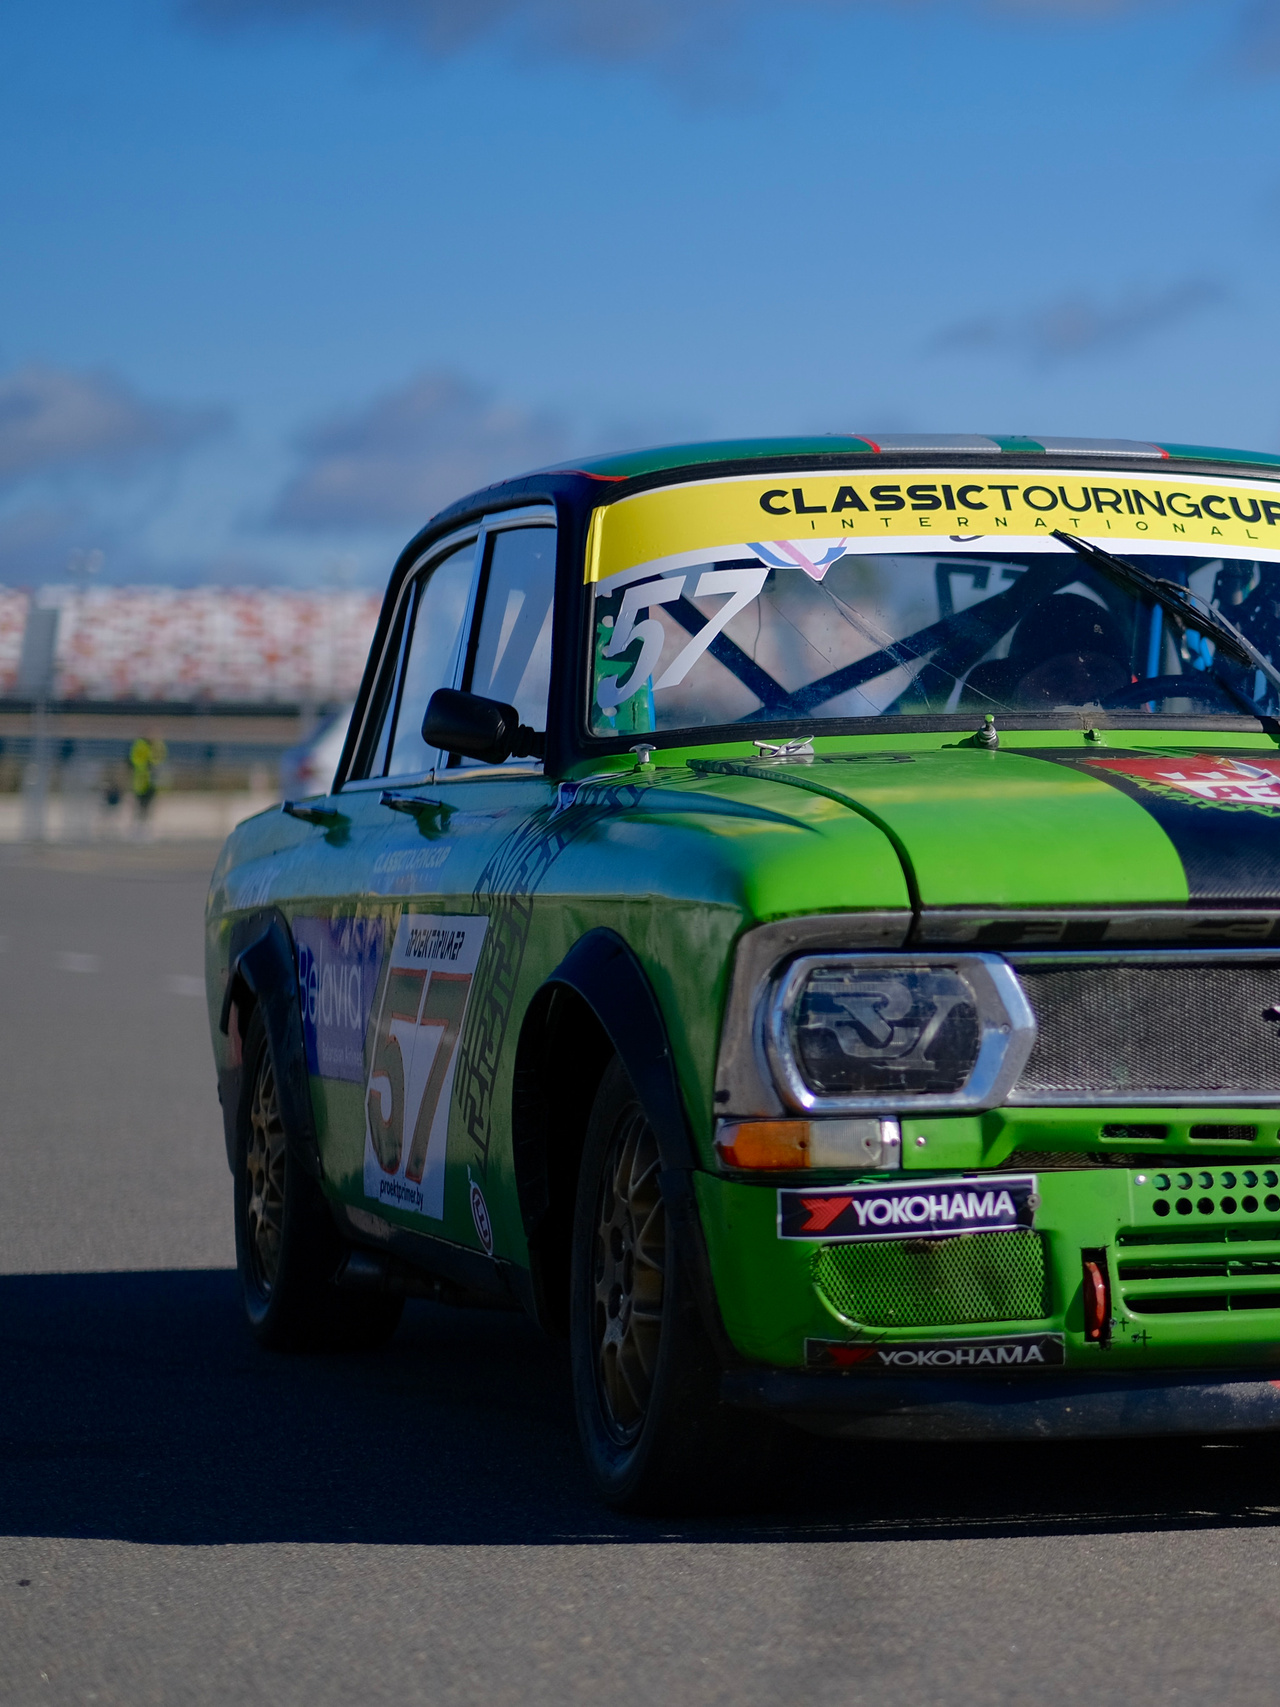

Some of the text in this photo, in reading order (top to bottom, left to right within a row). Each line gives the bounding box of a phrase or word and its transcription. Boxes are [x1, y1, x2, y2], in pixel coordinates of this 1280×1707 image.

[811, 517, 1259, 540] INTERNATIONAL
[598, 568, 770, 708] 57
[299, 940, 361, 1030] Belavia
[368, 967, 473, 1184] 57
[852, 1191, 1015, 1226] YOKOHAMA
[878, 1345, 1044, 1366] YOKOHAMA
